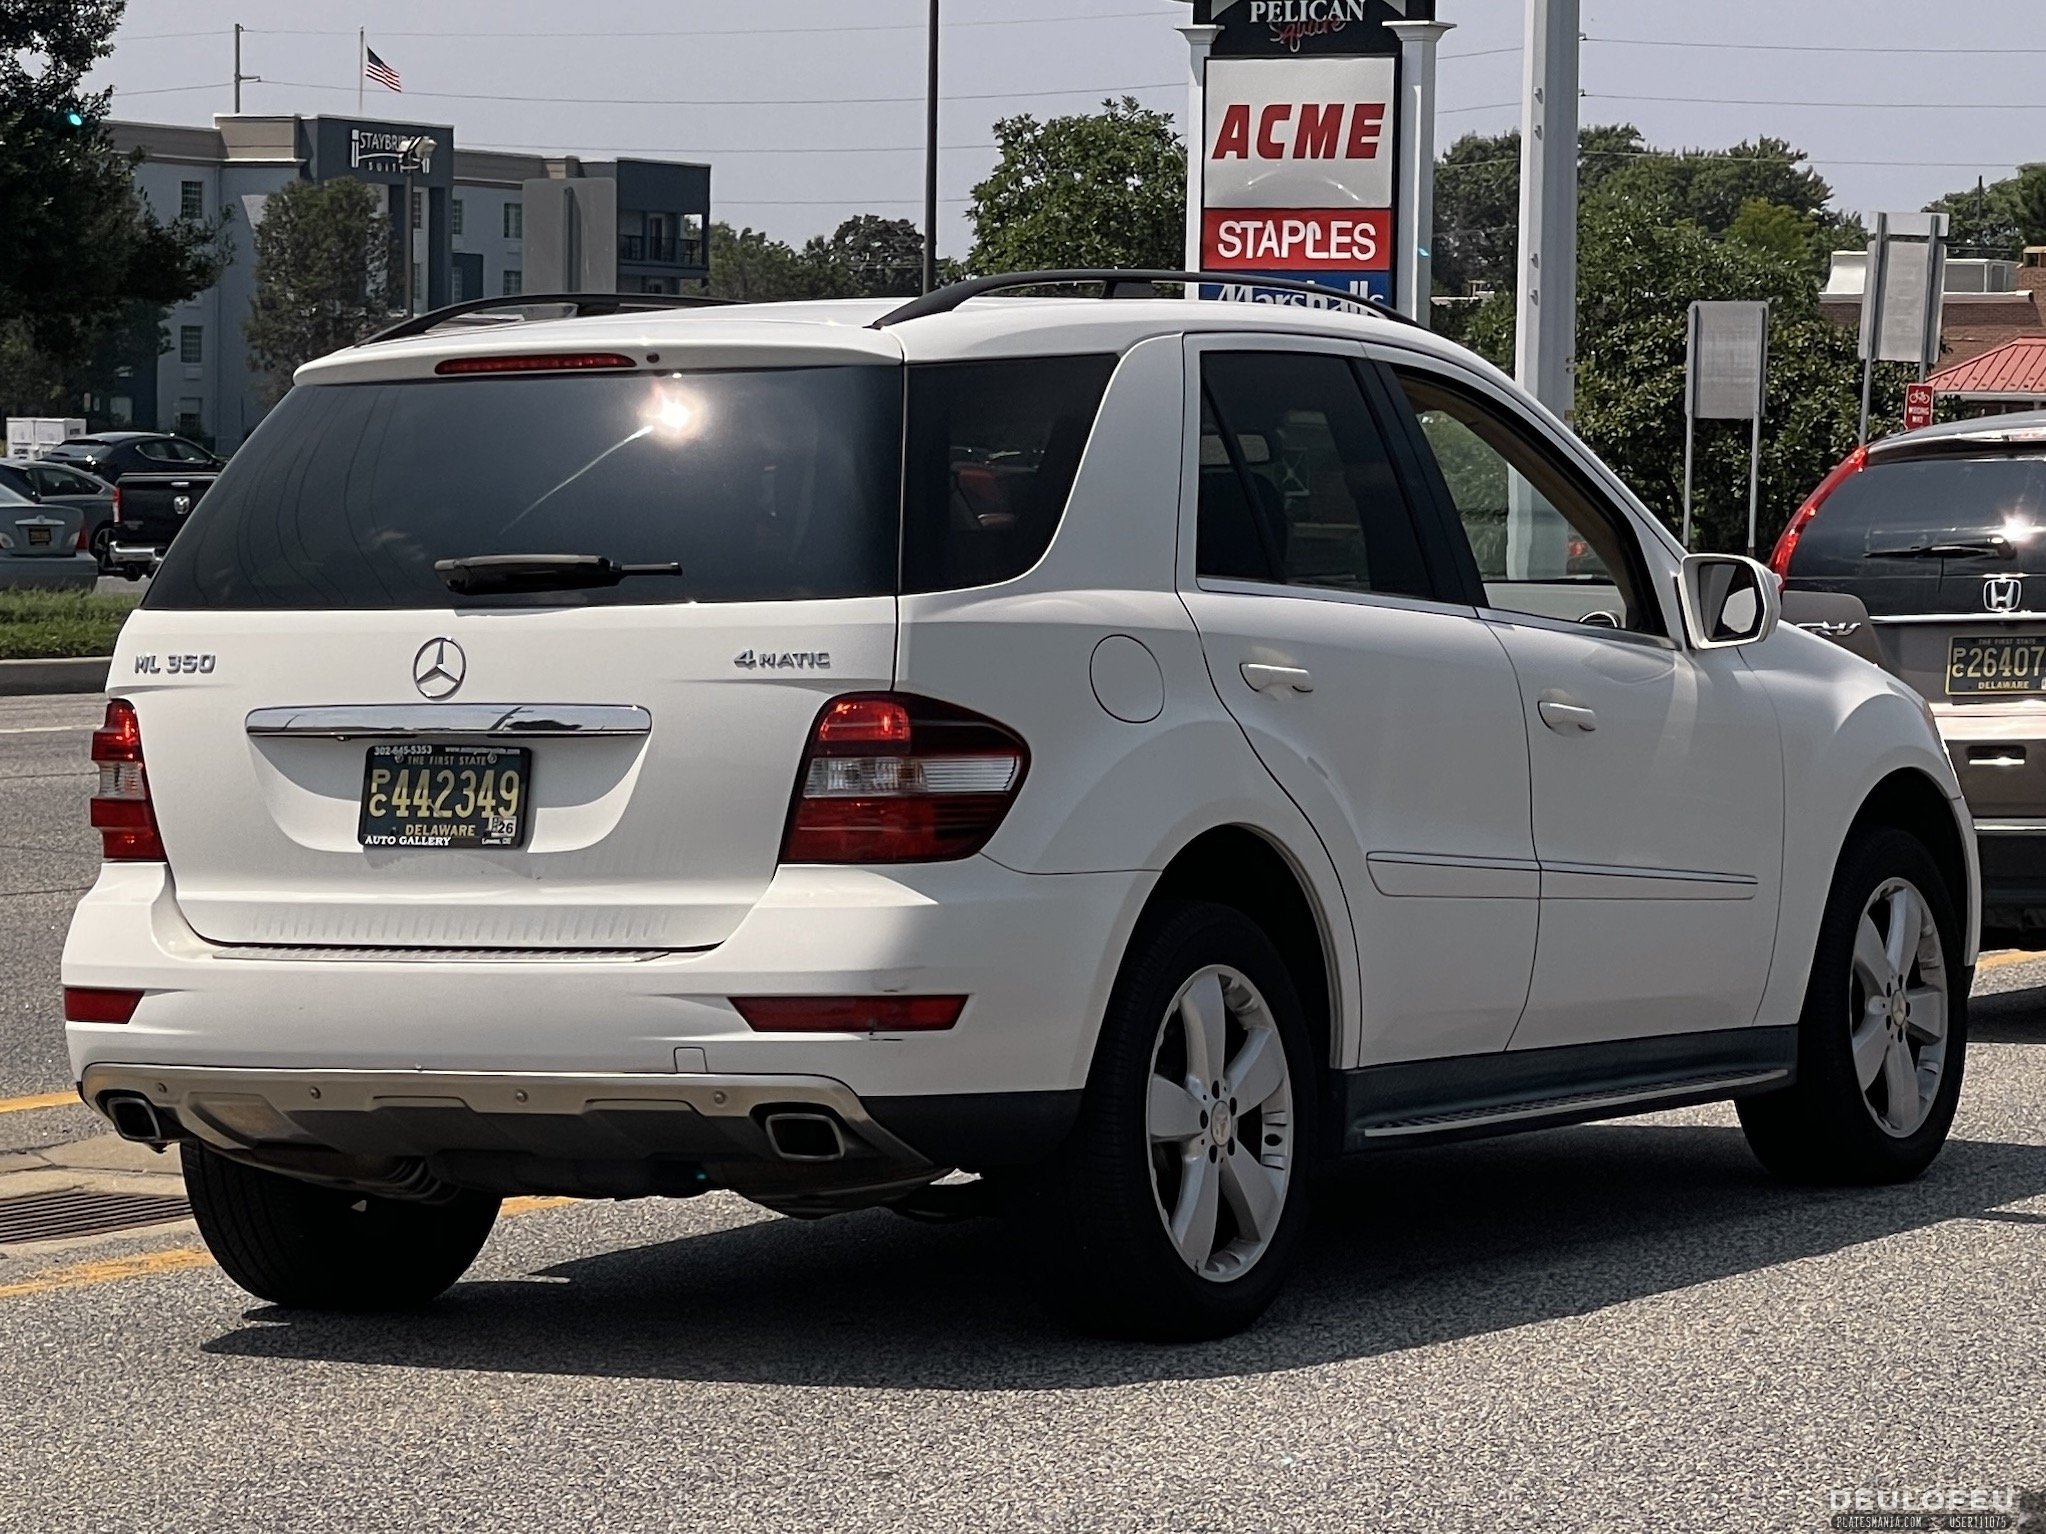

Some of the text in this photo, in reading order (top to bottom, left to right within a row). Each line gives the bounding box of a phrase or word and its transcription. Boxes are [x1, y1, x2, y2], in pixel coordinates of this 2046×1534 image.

[1249, 0, 1366, 23] PELICAN
[1268, 15, 1347, 53] Square
[1211, 102, 1386, 160] ACME
[1217, 219, 1377, 261] STAPLES
[134, 654, 216, 674] ML 350
[1977, 681, 2030, 690] DELAWARE
[407, 756, 487, 766] THE FIRST STATE
[391, 769, 520, 819] 442349
[405, 824, 476, 837] DELAWARE
[498, 821, 514, 834] 26
[364, 835, 452, 846] AUTO GALLERY
